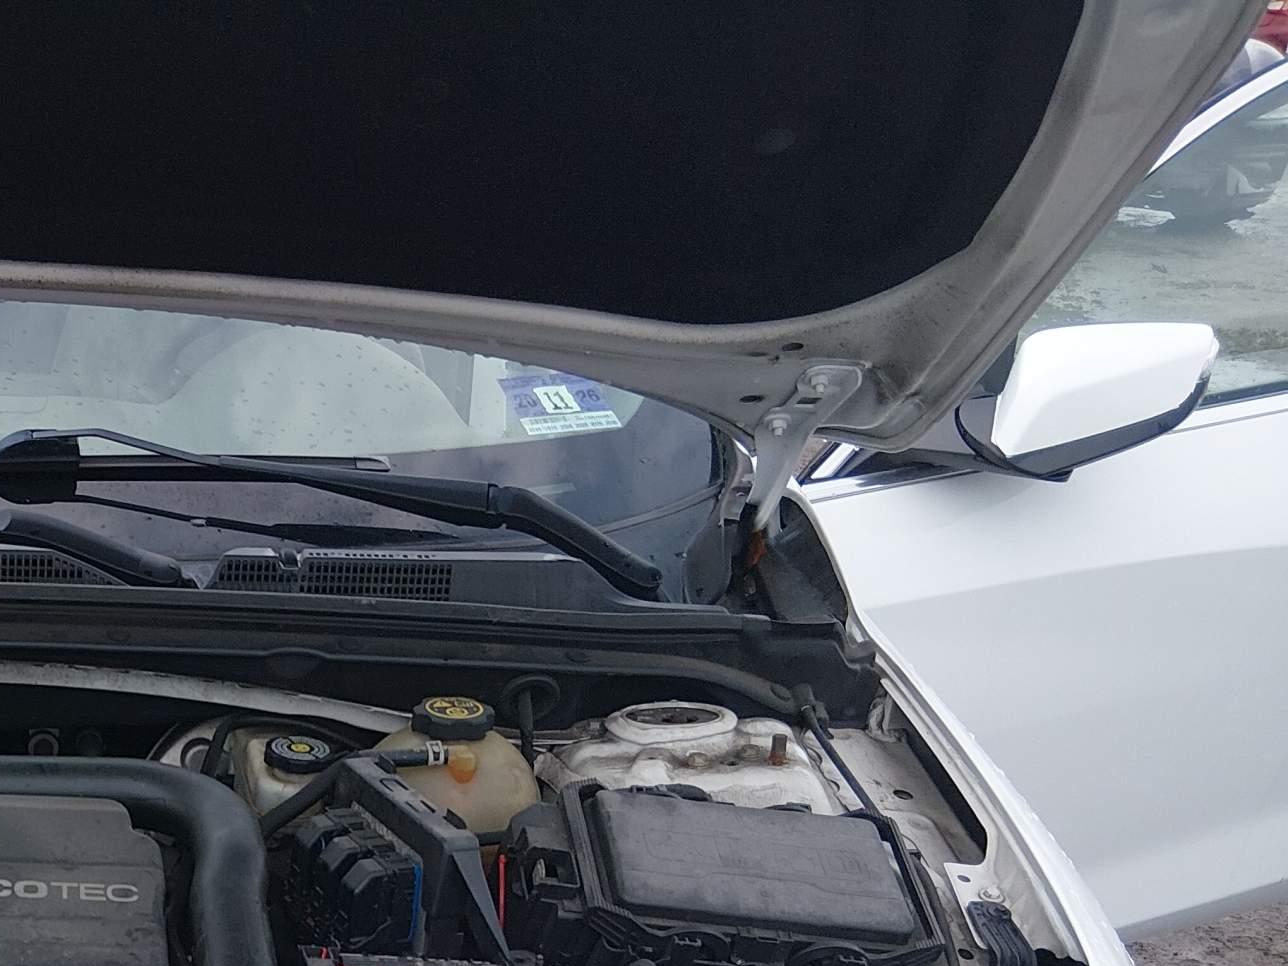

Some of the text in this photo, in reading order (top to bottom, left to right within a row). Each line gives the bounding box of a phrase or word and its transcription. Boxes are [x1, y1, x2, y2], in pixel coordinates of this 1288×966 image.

[514, 388, 602, 411] 20 11 26
